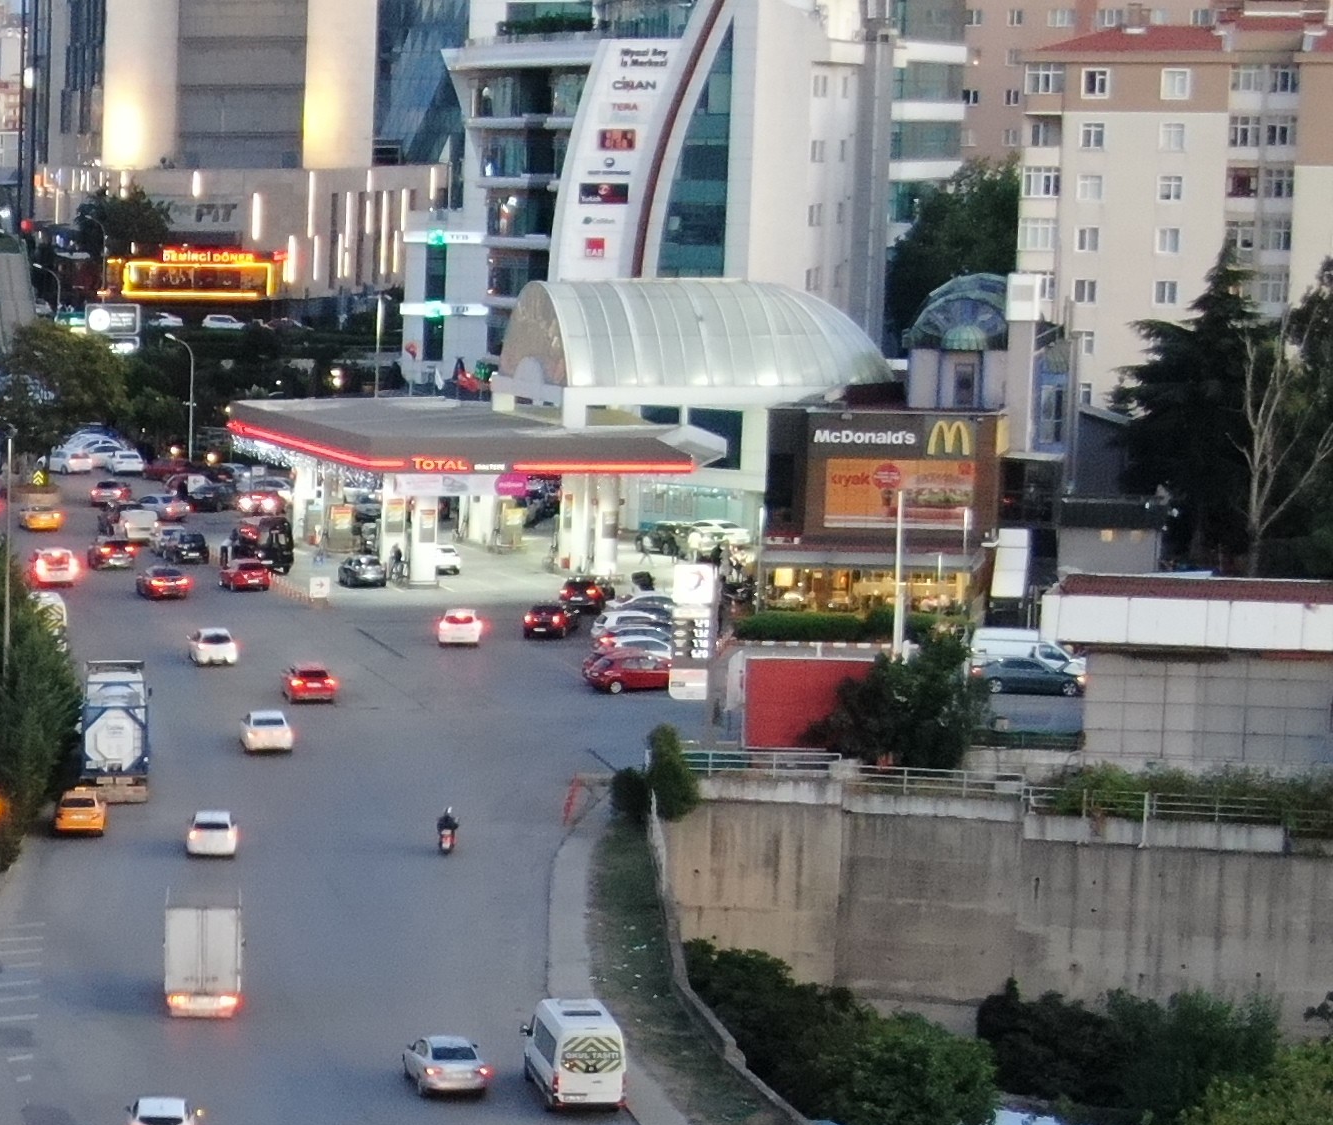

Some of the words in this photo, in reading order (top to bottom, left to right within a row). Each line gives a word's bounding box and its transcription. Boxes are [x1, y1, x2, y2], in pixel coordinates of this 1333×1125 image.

[813, 429, 916, 446] McDonald's
[412, 457, 468, 472] TOTAL
[565, 1052, 590, 1060] OKUL
